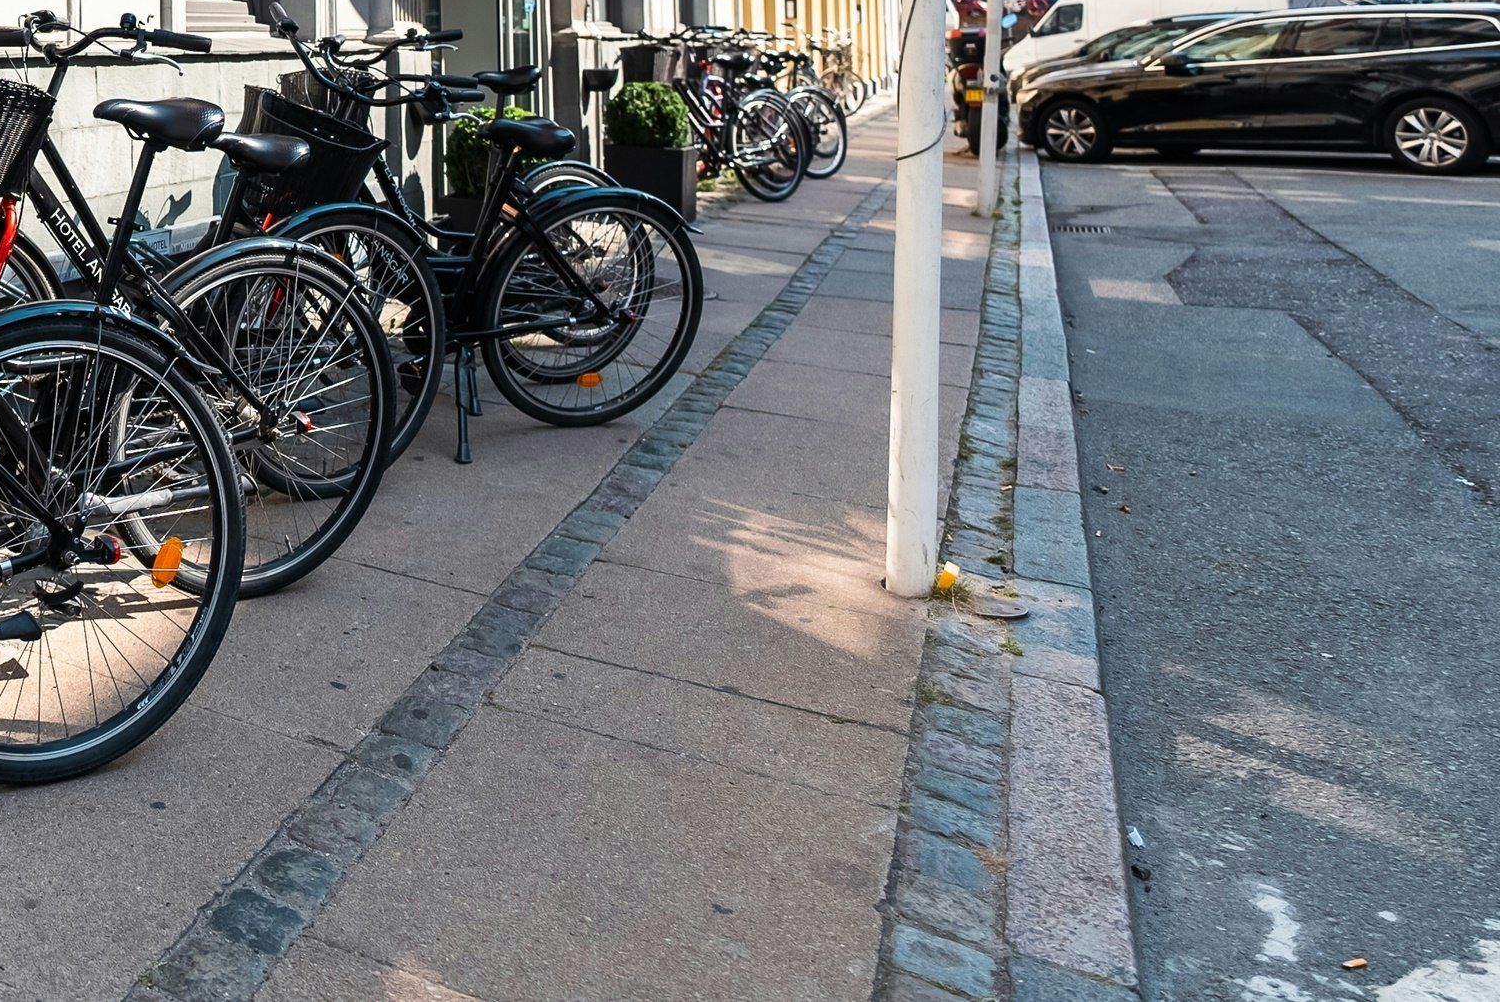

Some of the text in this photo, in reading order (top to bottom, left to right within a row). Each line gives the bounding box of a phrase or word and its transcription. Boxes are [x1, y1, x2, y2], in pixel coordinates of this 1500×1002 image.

[391, 182, 417, 228] ANSGAR
[50, 207, 88, 262] HOTEL
[372, 239, 409, 285] ANSGAR
